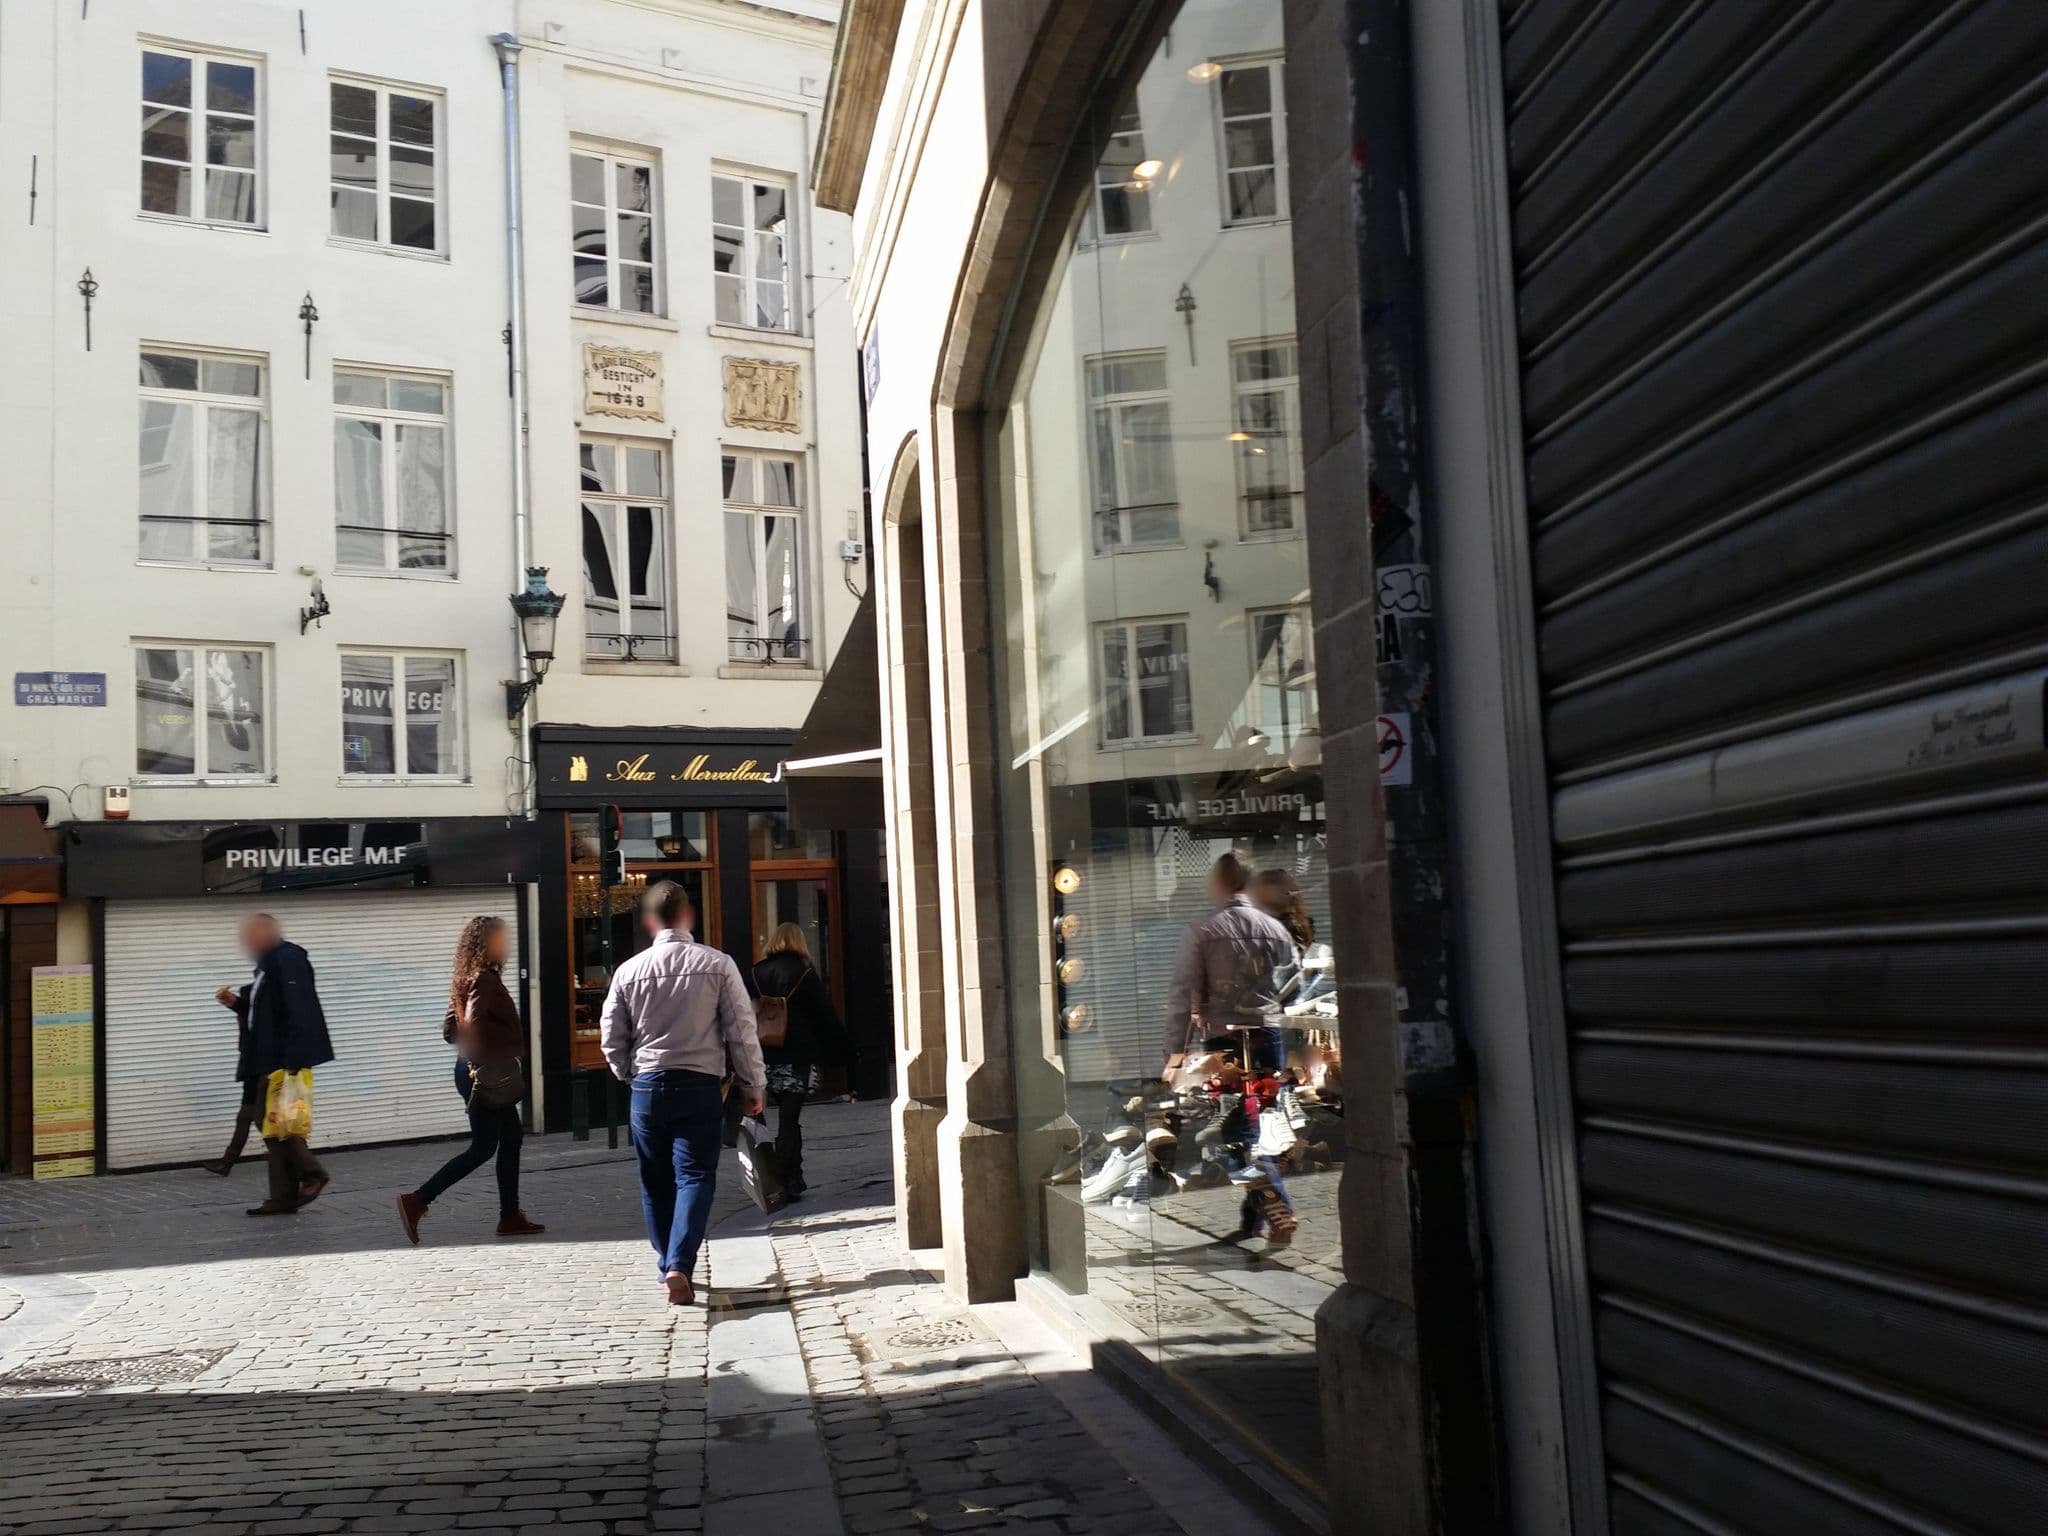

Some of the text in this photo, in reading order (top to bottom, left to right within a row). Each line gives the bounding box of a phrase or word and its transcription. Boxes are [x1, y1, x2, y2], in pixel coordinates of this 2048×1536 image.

[617, 383, 632, 392] IN
[607, 391, 644, 407] 1648
[26, 695, 95, 704] GRASMARKT
[606, 754, 772, 782] Aux Merveilleux
[226, 846, 407, 868] PRIVILEGE M.F
